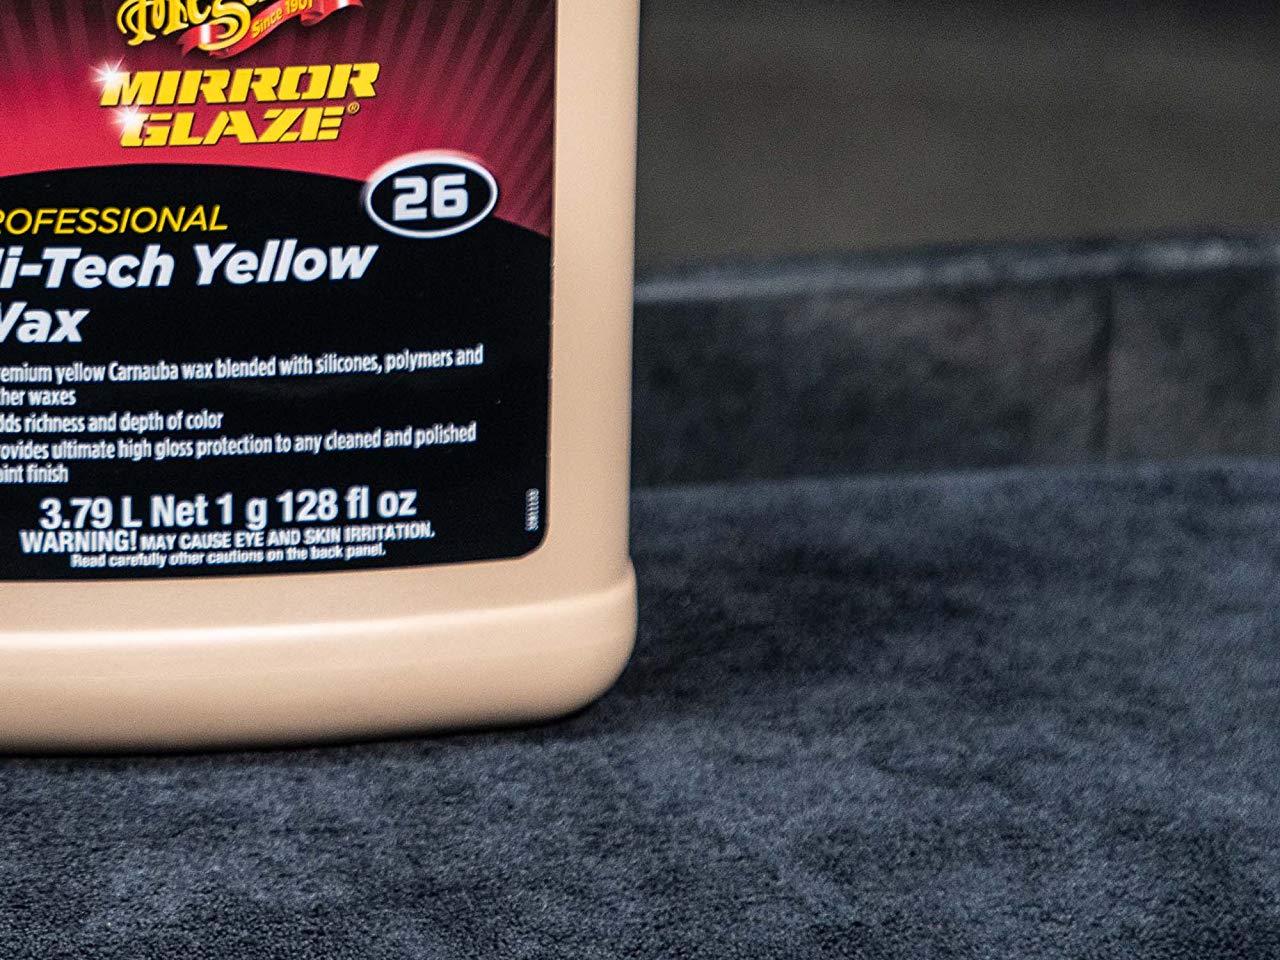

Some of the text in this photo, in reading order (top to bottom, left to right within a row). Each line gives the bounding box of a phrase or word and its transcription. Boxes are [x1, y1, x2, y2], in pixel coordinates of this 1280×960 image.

[251, 10, 282, 38] Since
[100, 62, 380, 106] MIRROR
[120, 107, 345, 147] GLAZE
[393, 173, 469, 221] 26
[193, 239, 378, 286] Yellow
[55, 361, 105, 385] yellow
[108, 360, 178, 382] Carnauba
[180, 362, 214, 381] wax
[215, 355, 276, 378] blended
[278, 354, 313, 376] with
[315, 353, 382, 375] silicones,
[384, 348, 453, 374] polymers
[455, 343, 484, 366] and
[28, 389, 76, 406] waxes
[24, 412, 85, 433] richness
[87, 411, 117, 432] and
[119, 410, 164, 434] depth
[166, 410, 183, 431] of
[185, 408, 224, 431] color
[51, 439, 115, 459] ultimate
[117, 438, 152, 461] high
[154, 437, 193, 461] gloss
[195, 434, 272, 459] protection
[274, 433, 292, 453] to
[294, 435, 321, 455] any
[324, 427, 381, 451] cleaned
[384, 425, 412, 448] and
[414, 420, 477, 449] polished
[26, 462, 69, 484] finish
[38, 485, 418, 531] 3.79 L Net 1 g 128 fl oz
[19, 520, 435, 554] WARNING! MAY CAUSE EYE AND SKIN IRRITATION.
[70, 542, 386, 569] Read carefully other cautions on the back panel.
